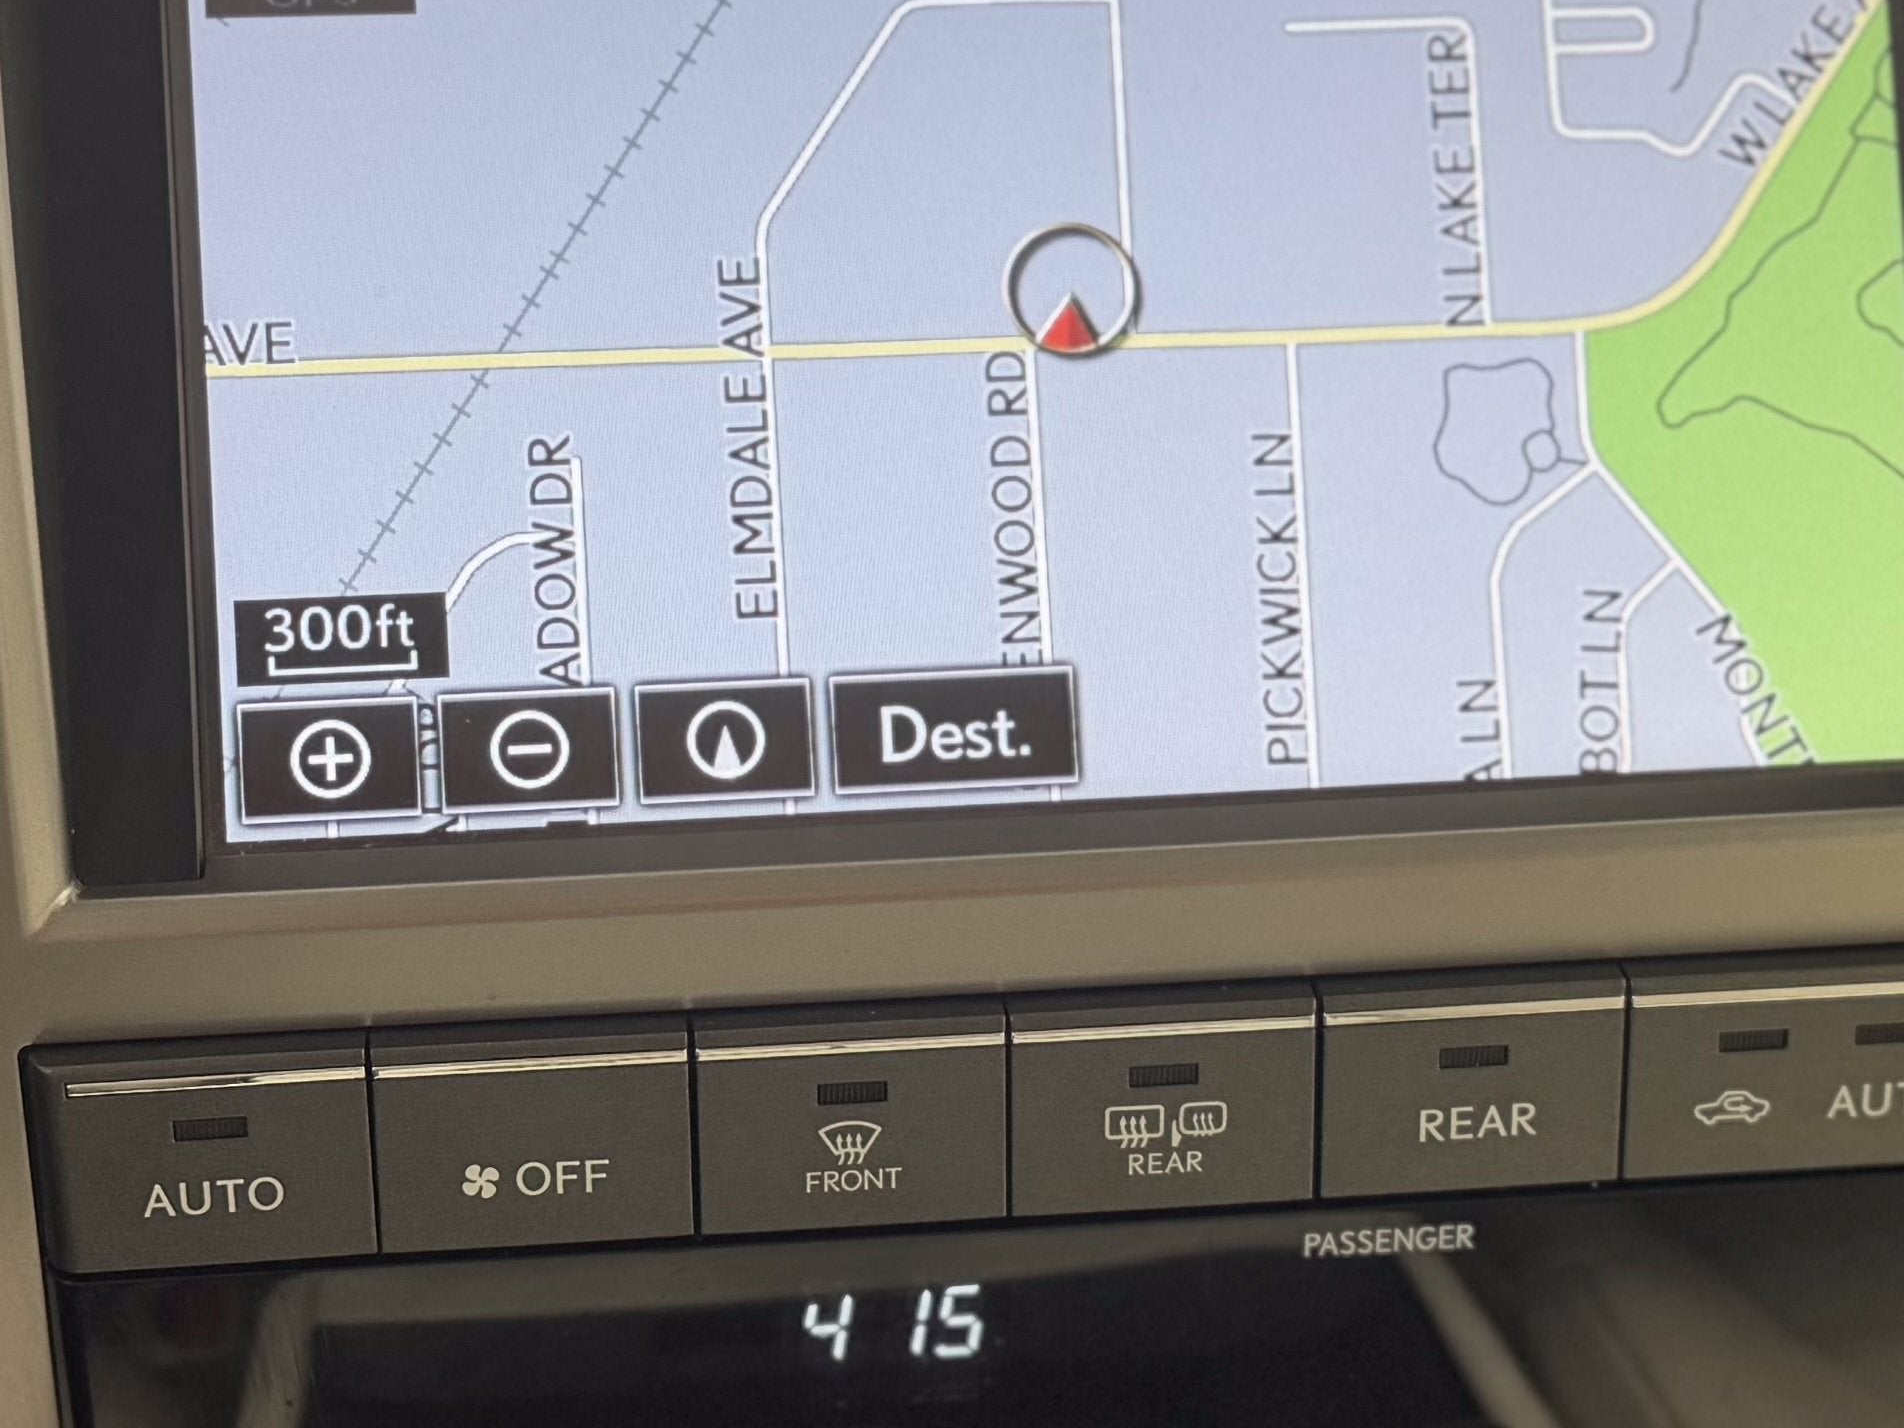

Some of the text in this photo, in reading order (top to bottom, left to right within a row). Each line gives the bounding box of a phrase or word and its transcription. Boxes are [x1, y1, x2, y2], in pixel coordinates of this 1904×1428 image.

[1718, 118, 1766, 166] W
[1754, 4, 1844, 126] LAKE
[1428, 35, 1486, 327] N LAKE TER
[986, 351, 1028, 417] RD
[718, 257, 779, 620] ELMDALE AVE
[528, 435, 583, 686] ADOW DR
[264, 603, 415, 653] 300ft
[1252, 434, 1308, 766] PICKWICK LN
[1580, 589, 1623, 653] LN
[1456, 680, 1501, 743] LN
[1695, 613, 1814, 767] MONT
[880, 705, 1031, 763] Dest.
[1419, 1103, 1536, 1143] REAR
[516, 1159, 610, 1197] OFF
[805, 1166, 903, 1194] FRONT
[1127, 1150, 1203, 1176] REAR
[144, 1177, 285, 1219] AUTO
[1304, 1224, 1475, 1258] PASSENGER
